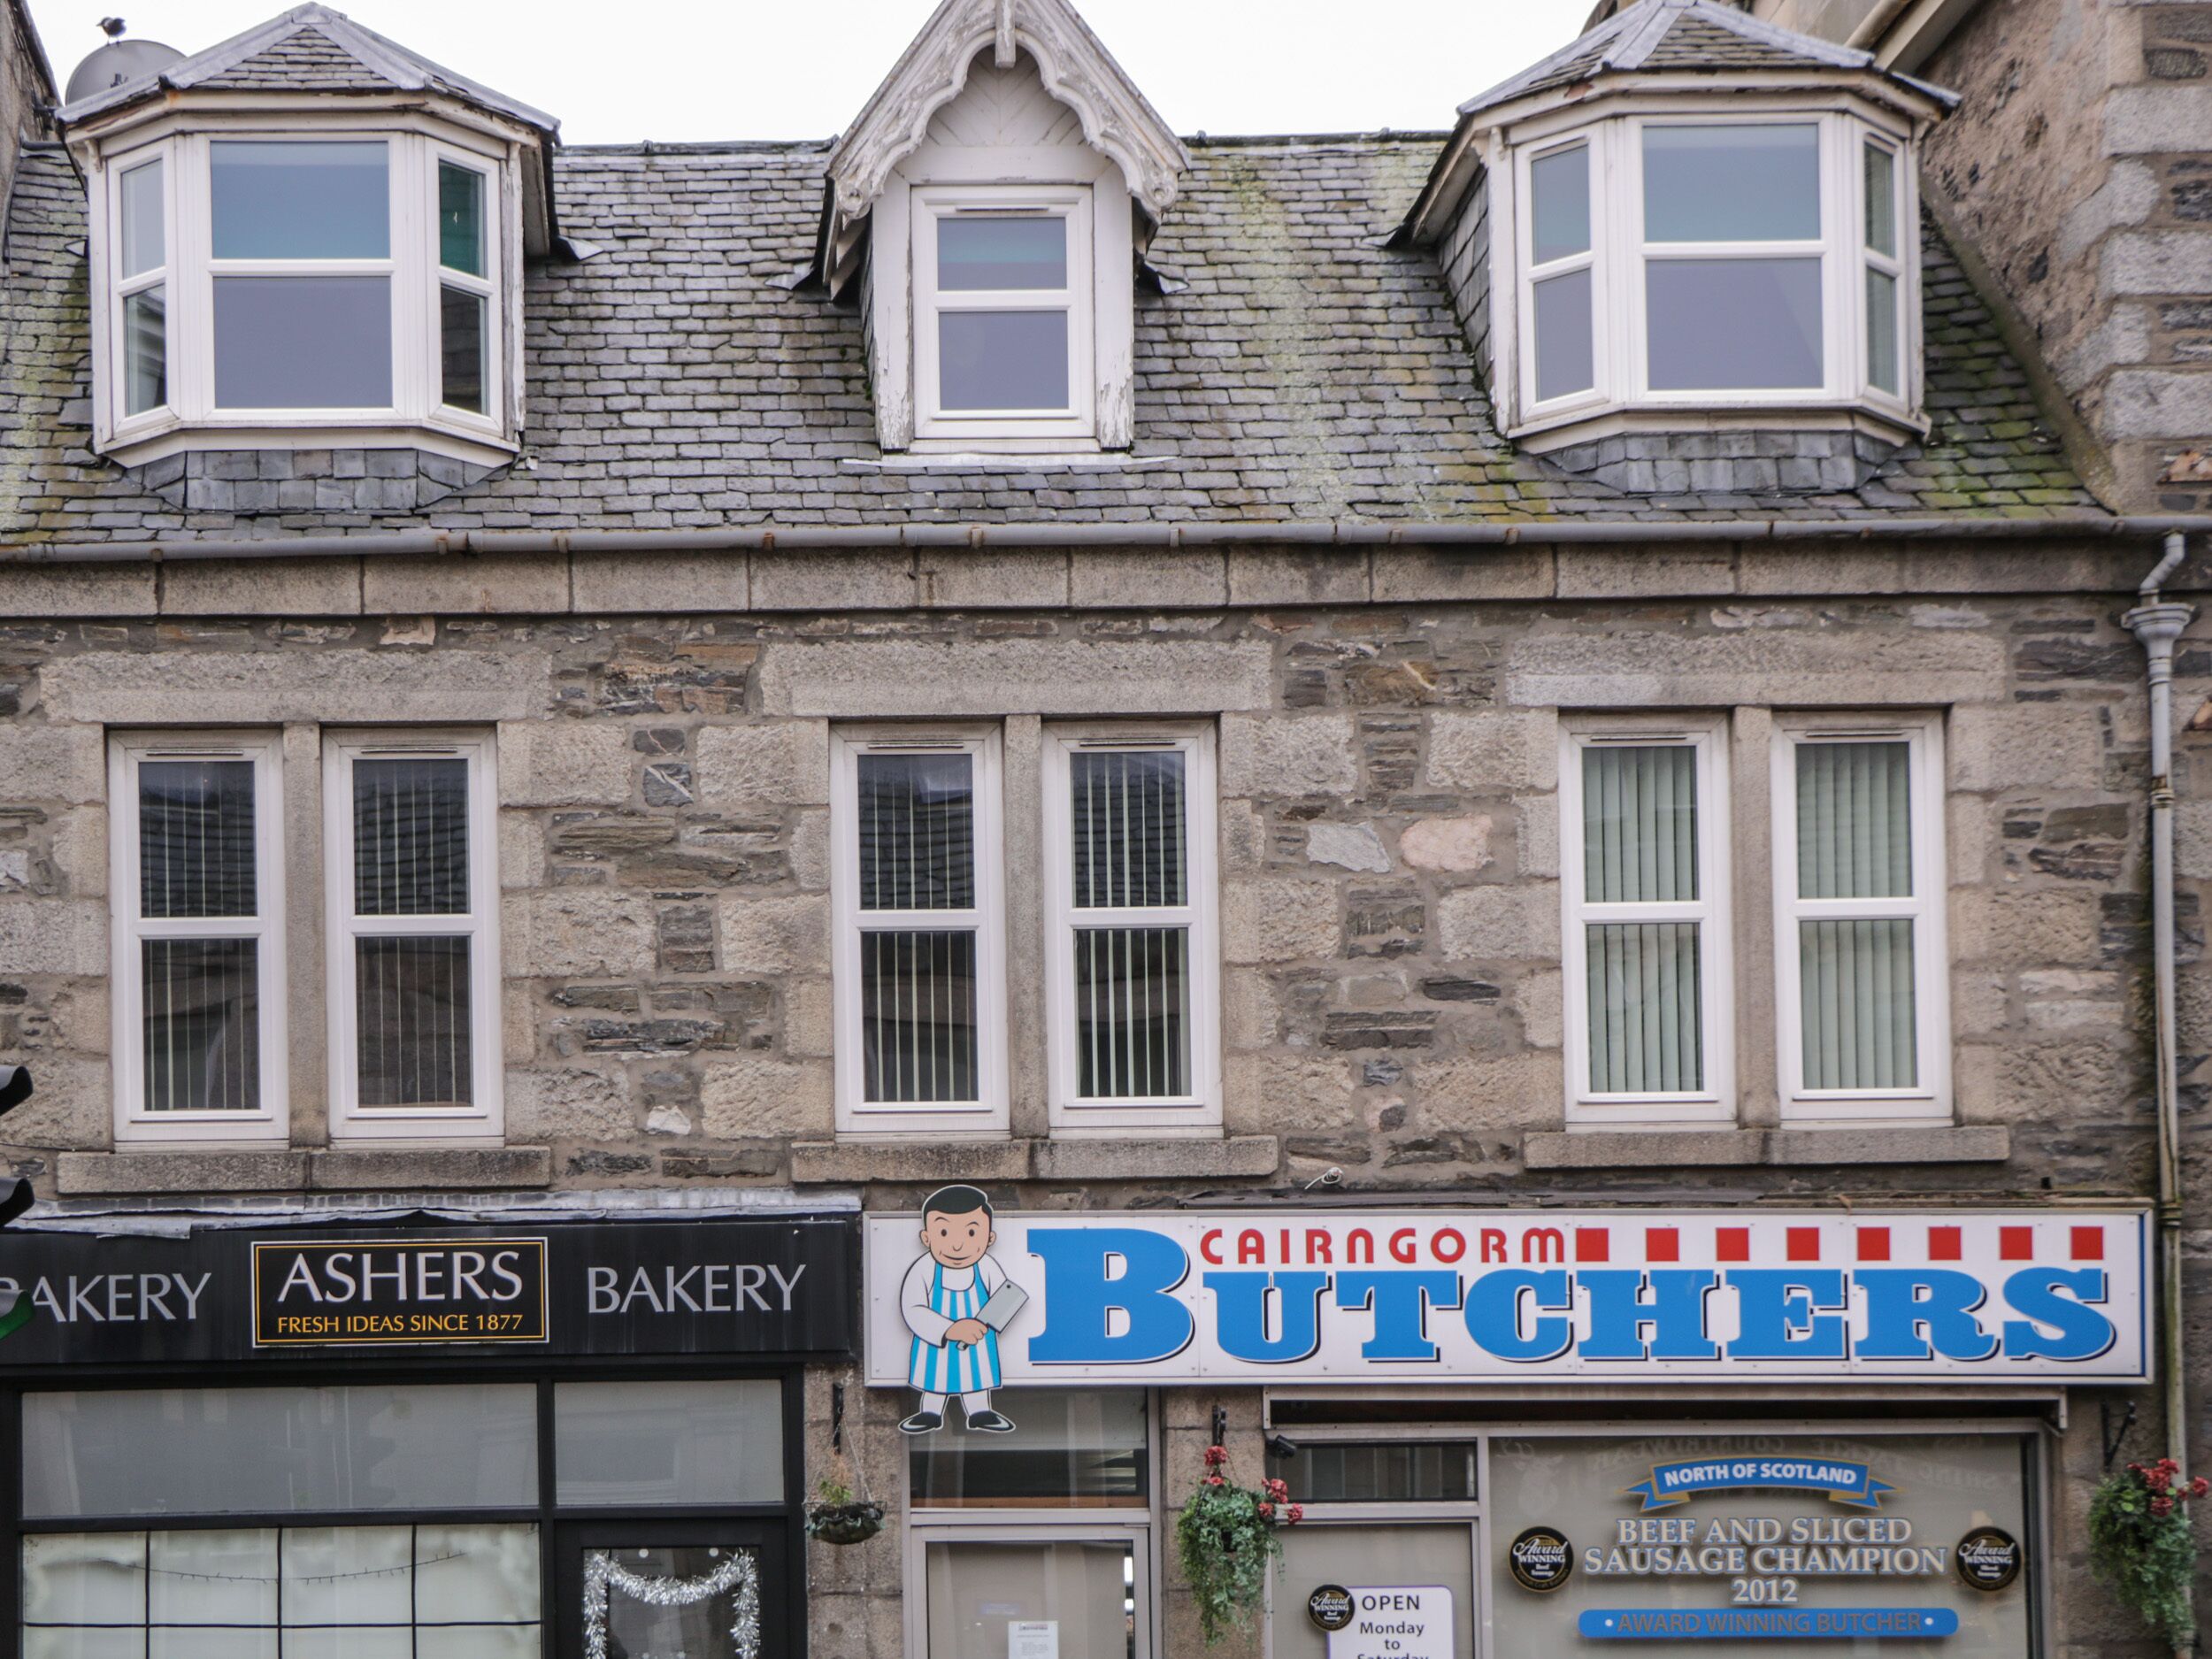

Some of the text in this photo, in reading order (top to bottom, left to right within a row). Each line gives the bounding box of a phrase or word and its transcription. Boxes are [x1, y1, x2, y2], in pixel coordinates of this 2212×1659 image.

[1200, 1226, 1564, 1264] CAIRNGORM
[277, 1251, 523, 1302] ASHERS
[588, 1263, 806, 1313] BAKERY
[0, 1272, 211, 1322] AKERY
[1027, 1227, 2116, 1364] BUTCHERS
[277, 1313, 523, 1333] FRESH IDEAS SINCE 1877
[1664, 1463, 1856, 1487] NORTH OF SCOTLAND
[1617, 1517, 1912, 1544] BEEF AND SLICED
[1513, 1538, 1568, 1555] Award
[1519, 1555, 1565, 1563] WINNING
[1585, 1548, 1945, 1574] SAUSAGE CHAMPION
[1362, 1595, 1420, 1610] OPEN
[1732, 1578, 1798, 1603] 2012
[1360, 1622, 1425, 1637] Monday
[1617, 1614, 1922, 1632] AWARD WINNING BUTCHER
[1385, 1640, 1401, 1650] to
